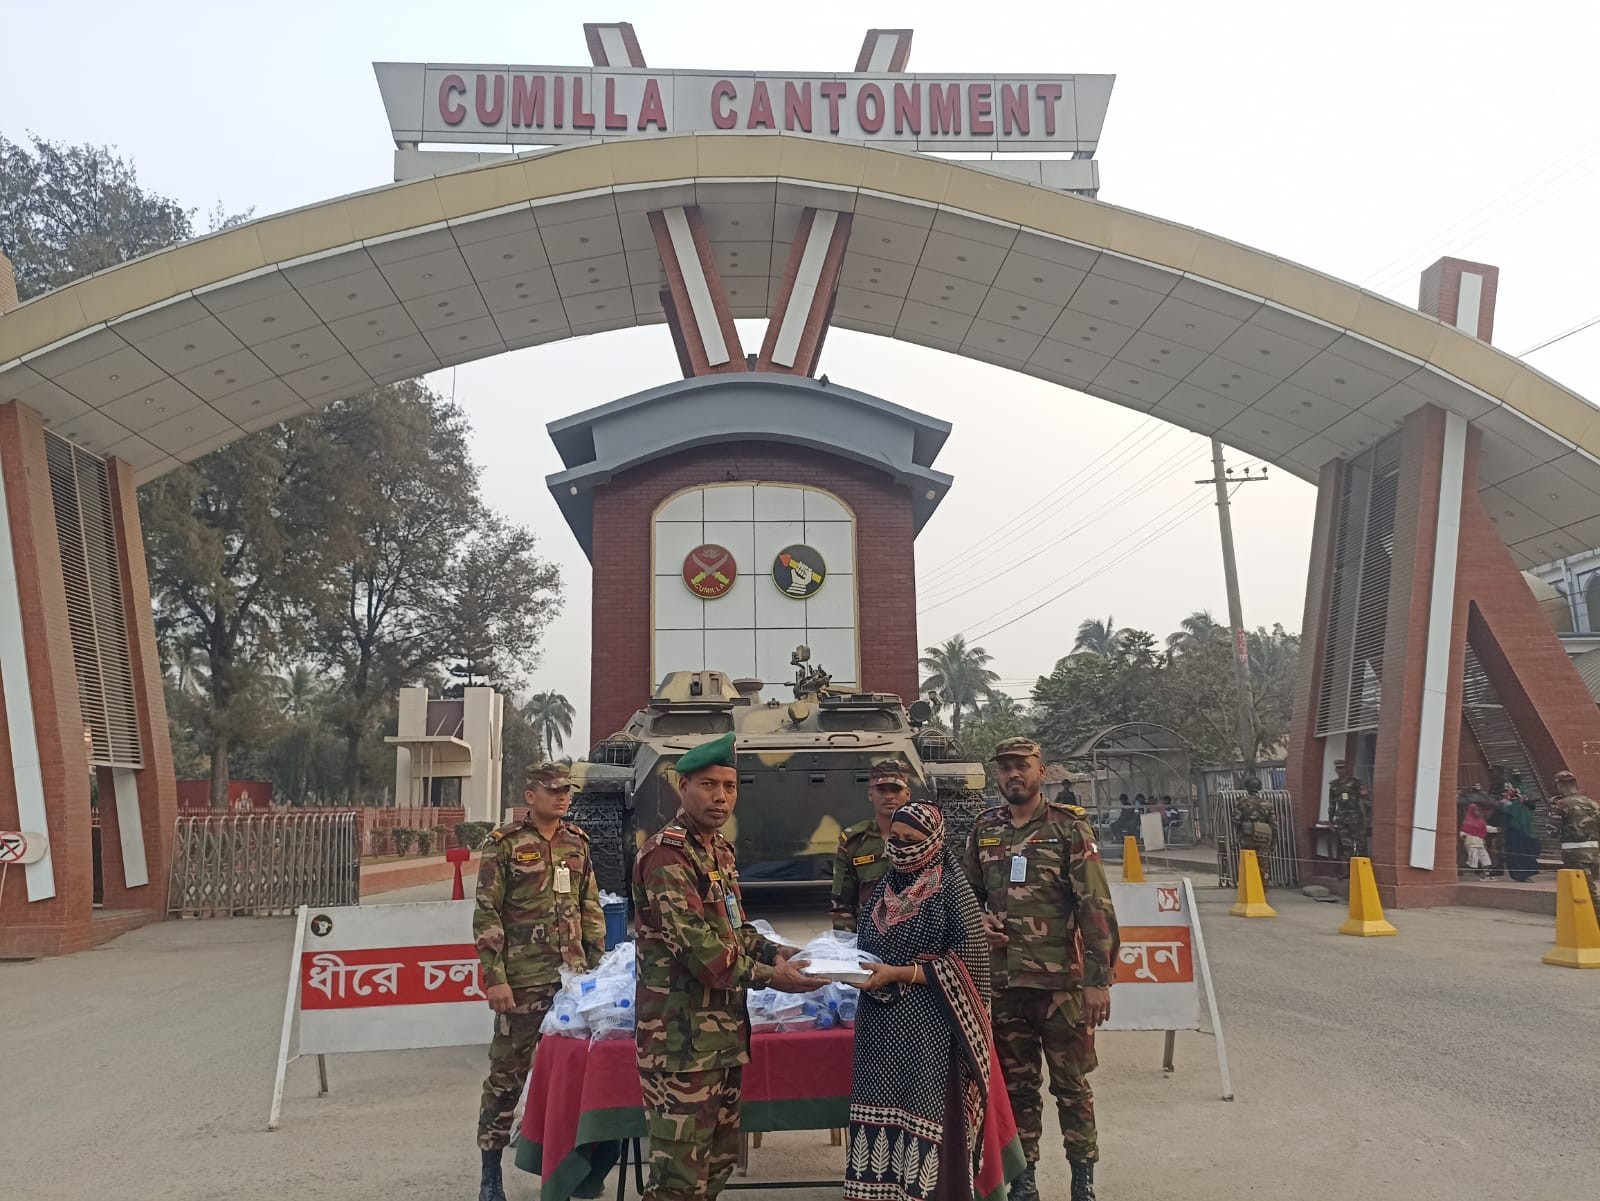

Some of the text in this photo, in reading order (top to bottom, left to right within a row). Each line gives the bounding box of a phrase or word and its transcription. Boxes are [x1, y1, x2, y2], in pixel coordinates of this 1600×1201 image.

[438, 74, 1062, 135] CUMILLA CANTONMENT
[694, 583, 726, 594] CUMILLA
[308, 953, 488, 1001] ধীরে চলু
[1118, 941, 1185, 983] লুন
